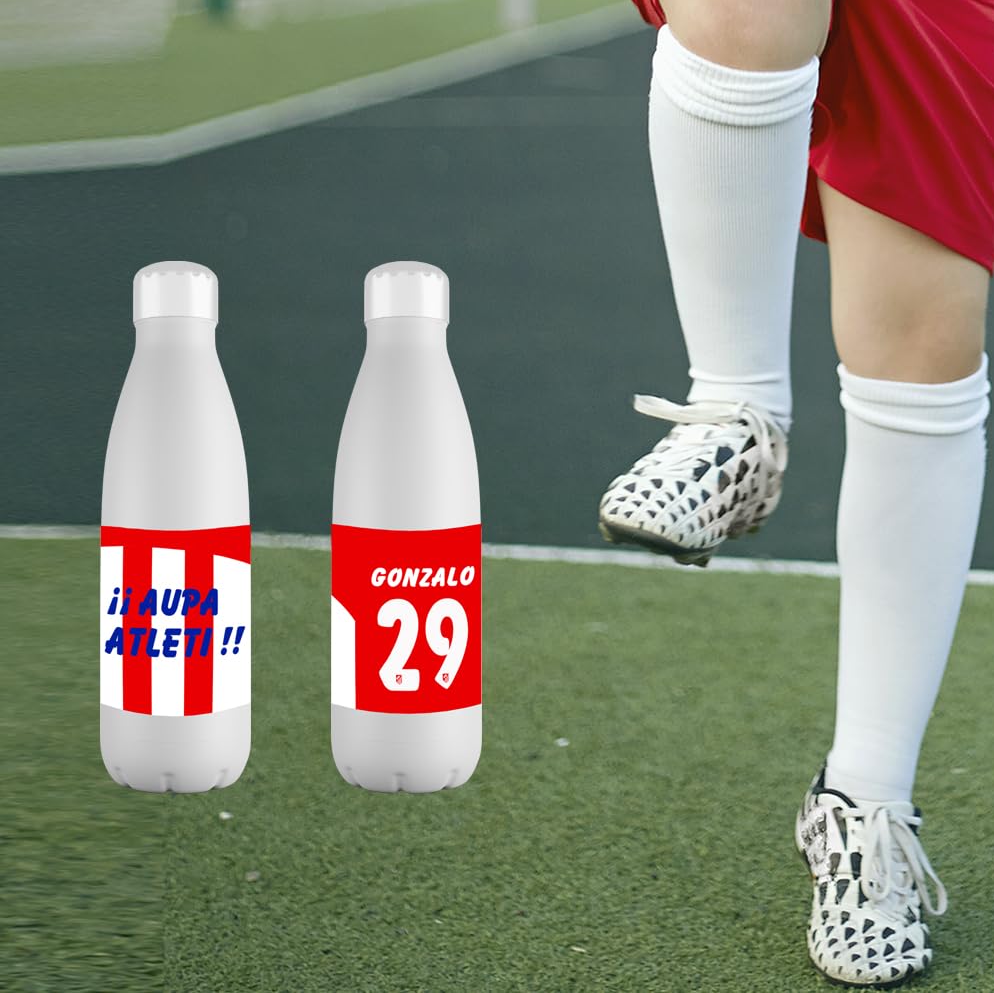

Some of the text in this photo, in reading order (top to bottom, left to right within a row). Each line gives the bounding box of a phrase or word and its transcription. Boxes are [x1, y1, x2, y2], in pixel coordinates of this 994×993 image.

[371, 565, 475, 588] GONZALO
[138, 588, 218, 617] AUPA
[105, 626, 213, 658] ATLETI
[377, 598, 469, 692] 29
